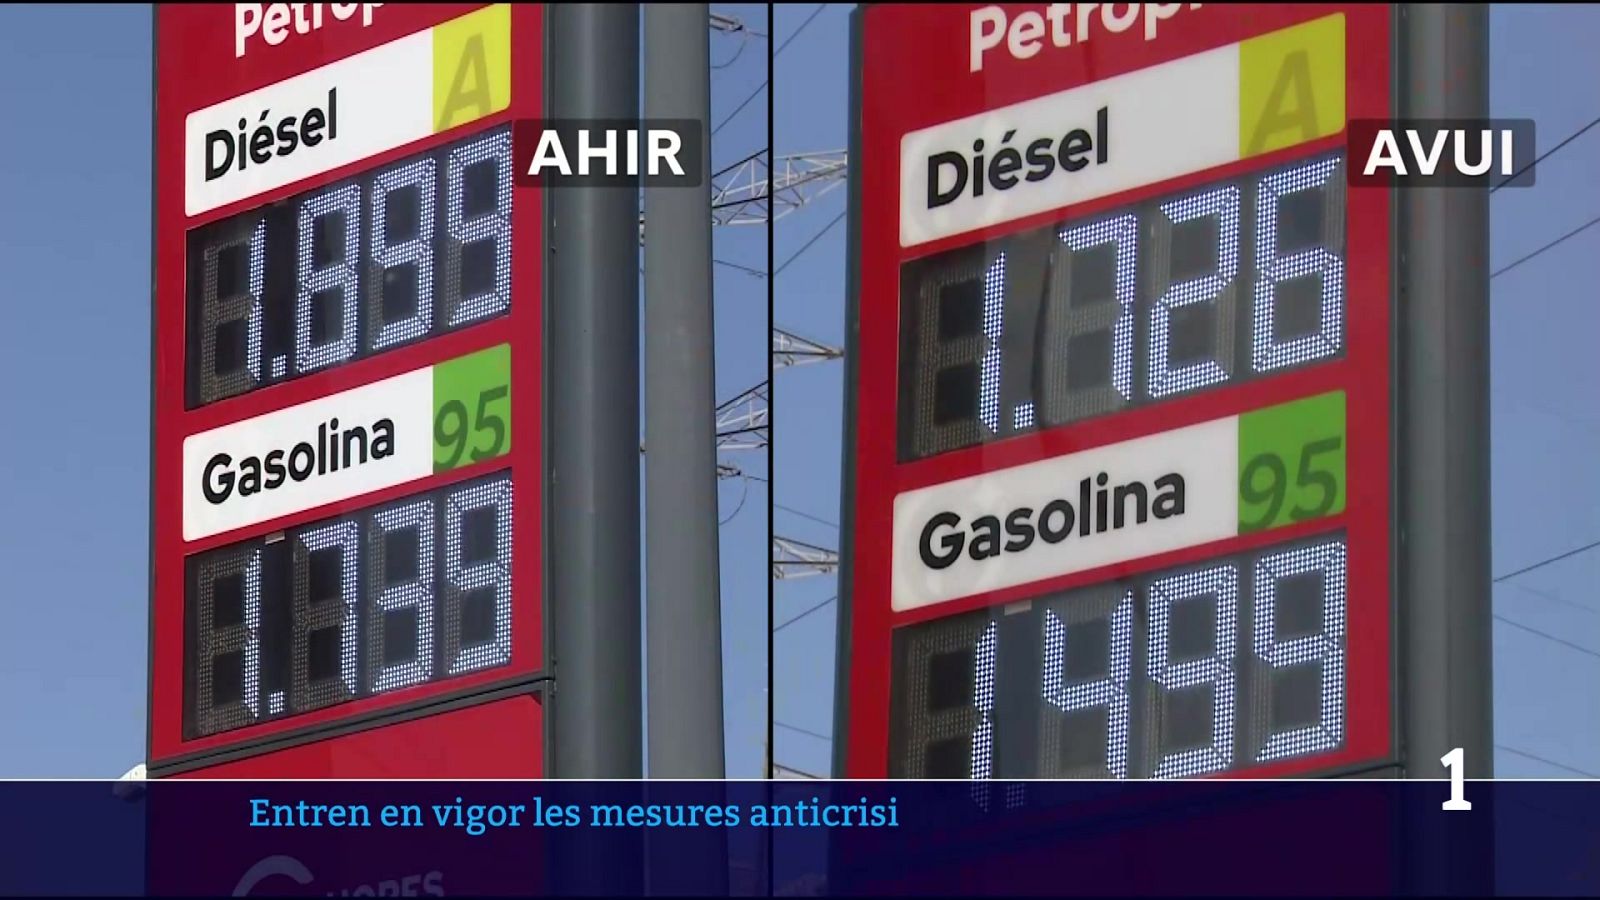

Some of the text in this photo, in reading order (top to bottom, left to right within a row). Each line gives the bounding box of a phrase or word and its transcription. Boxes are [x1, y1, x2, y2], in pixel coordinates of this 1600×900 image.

[205, 33, 492, 181] Diésel A
[927, 50, 1320, 209] Diésel A
[247, 130, 513, 382] 1.899
[979, 157, 1342, 434] 1.726
[202, 385, 508, 504] Gasolina 95
[919, 437, 1342, 570] Gasolina 95
[244, 478, 513, 718] 1.739
